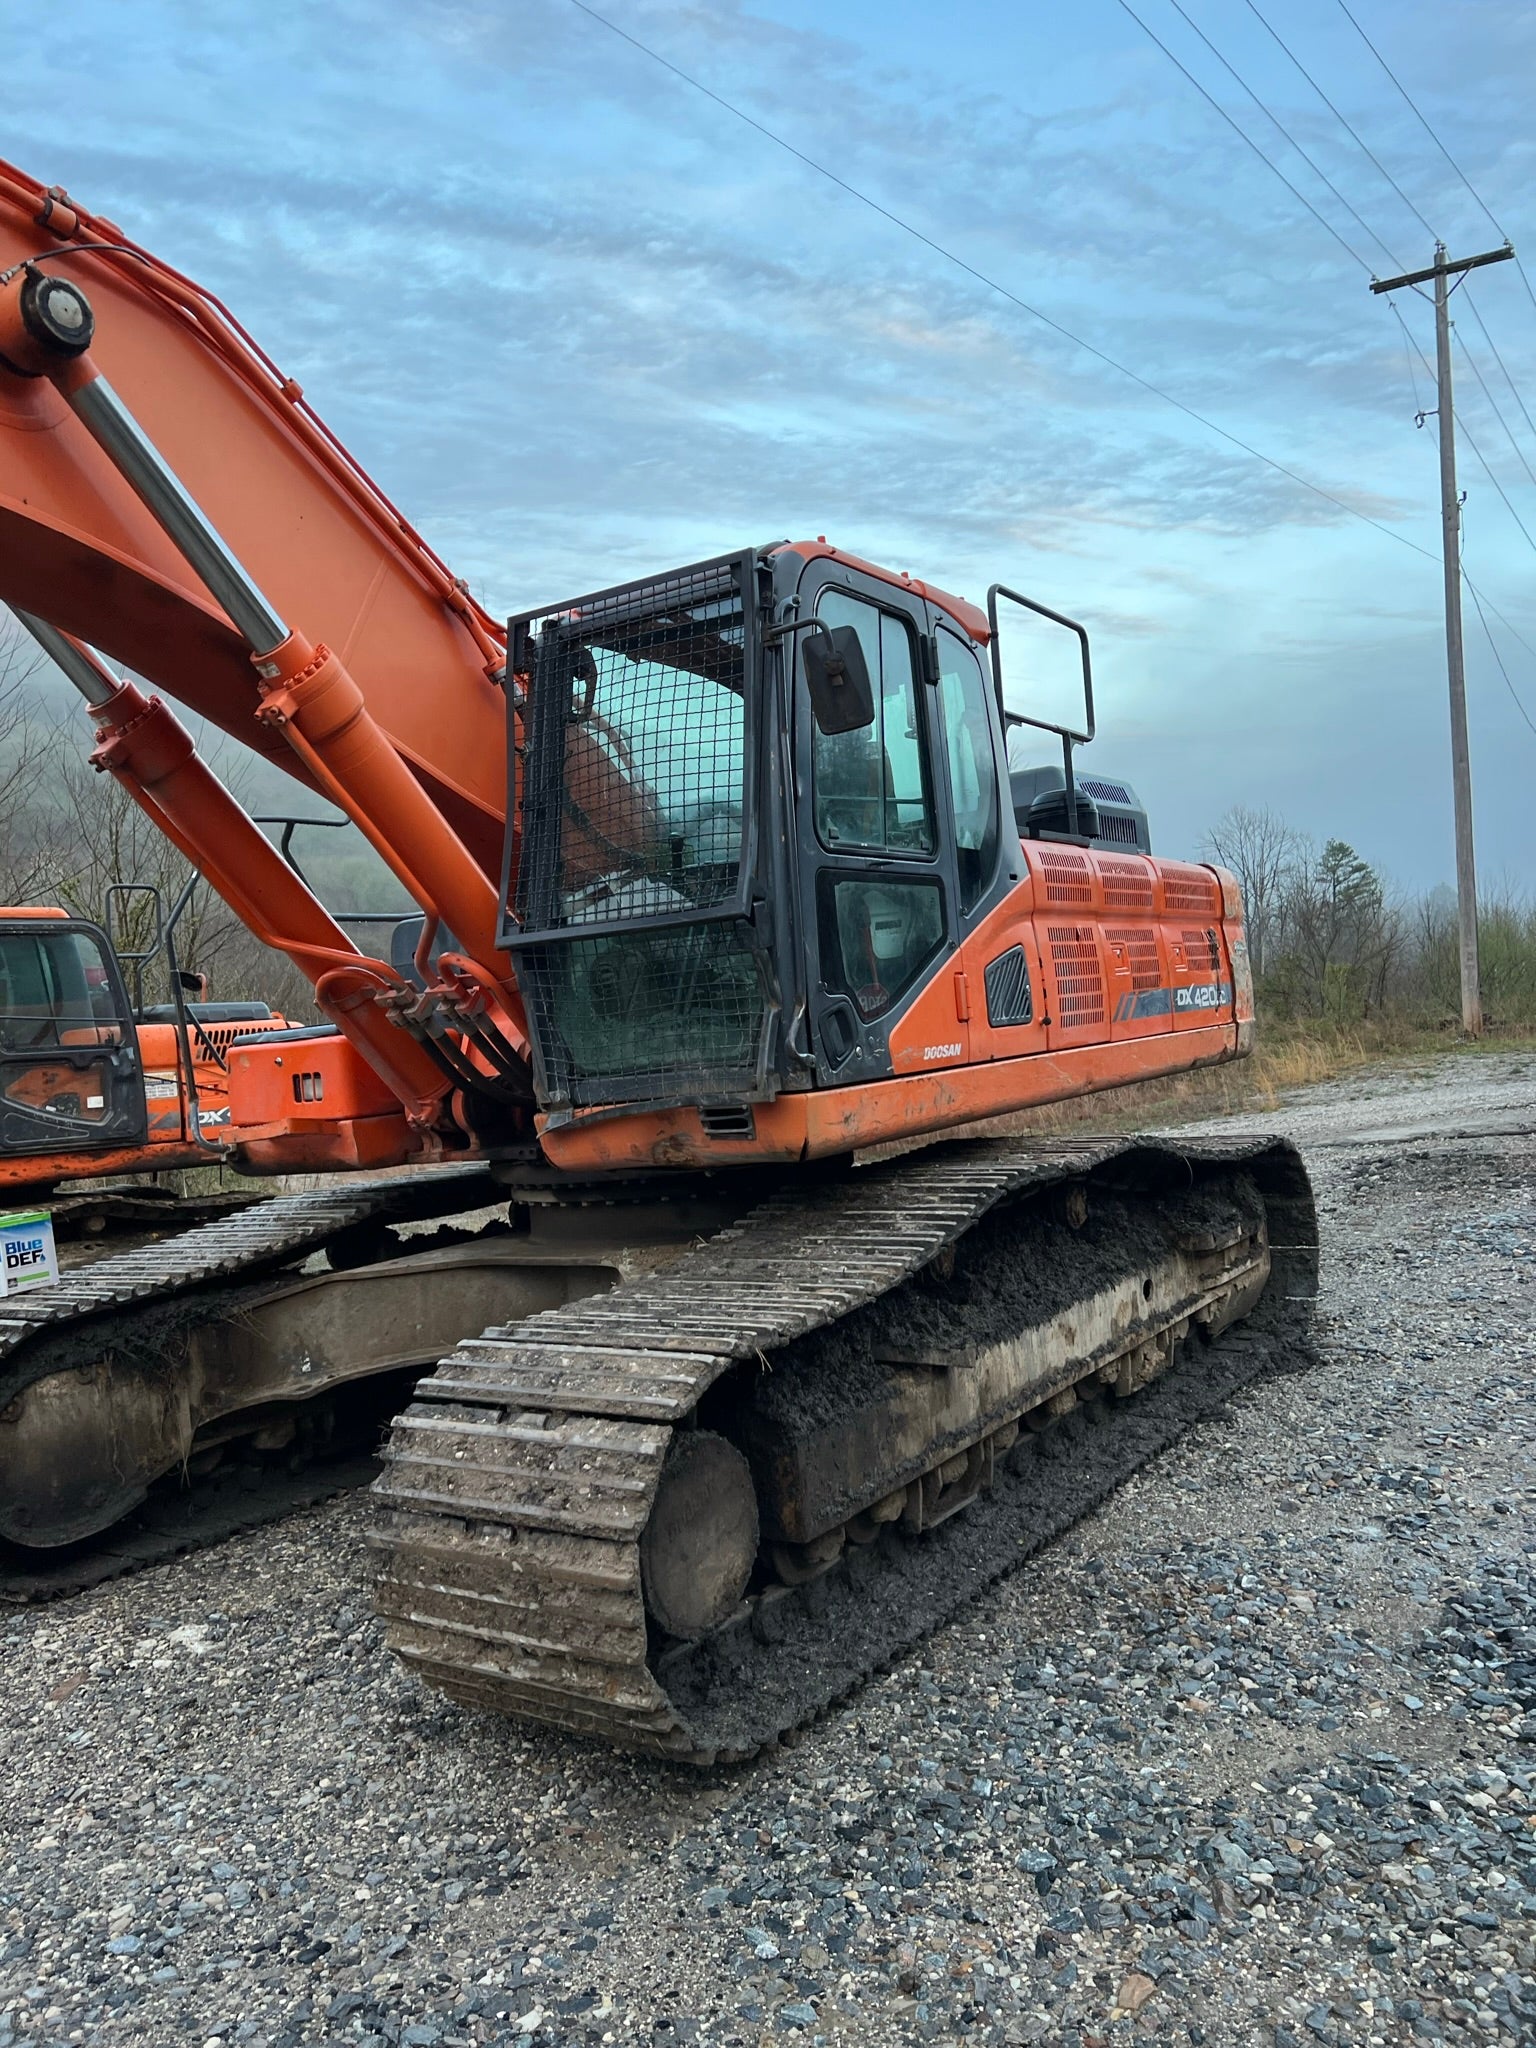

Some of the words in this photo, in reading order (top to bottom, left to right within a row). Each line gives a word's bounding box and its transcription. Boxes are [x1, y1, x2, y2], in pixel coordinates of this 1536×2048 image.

[923, 1043, 961, 1060] DOOSAN
[198, 1106, 231, 1126] DX
[5, 1239, 43, 1255] Blue
[7, 1249, 43, 1269] DEF
